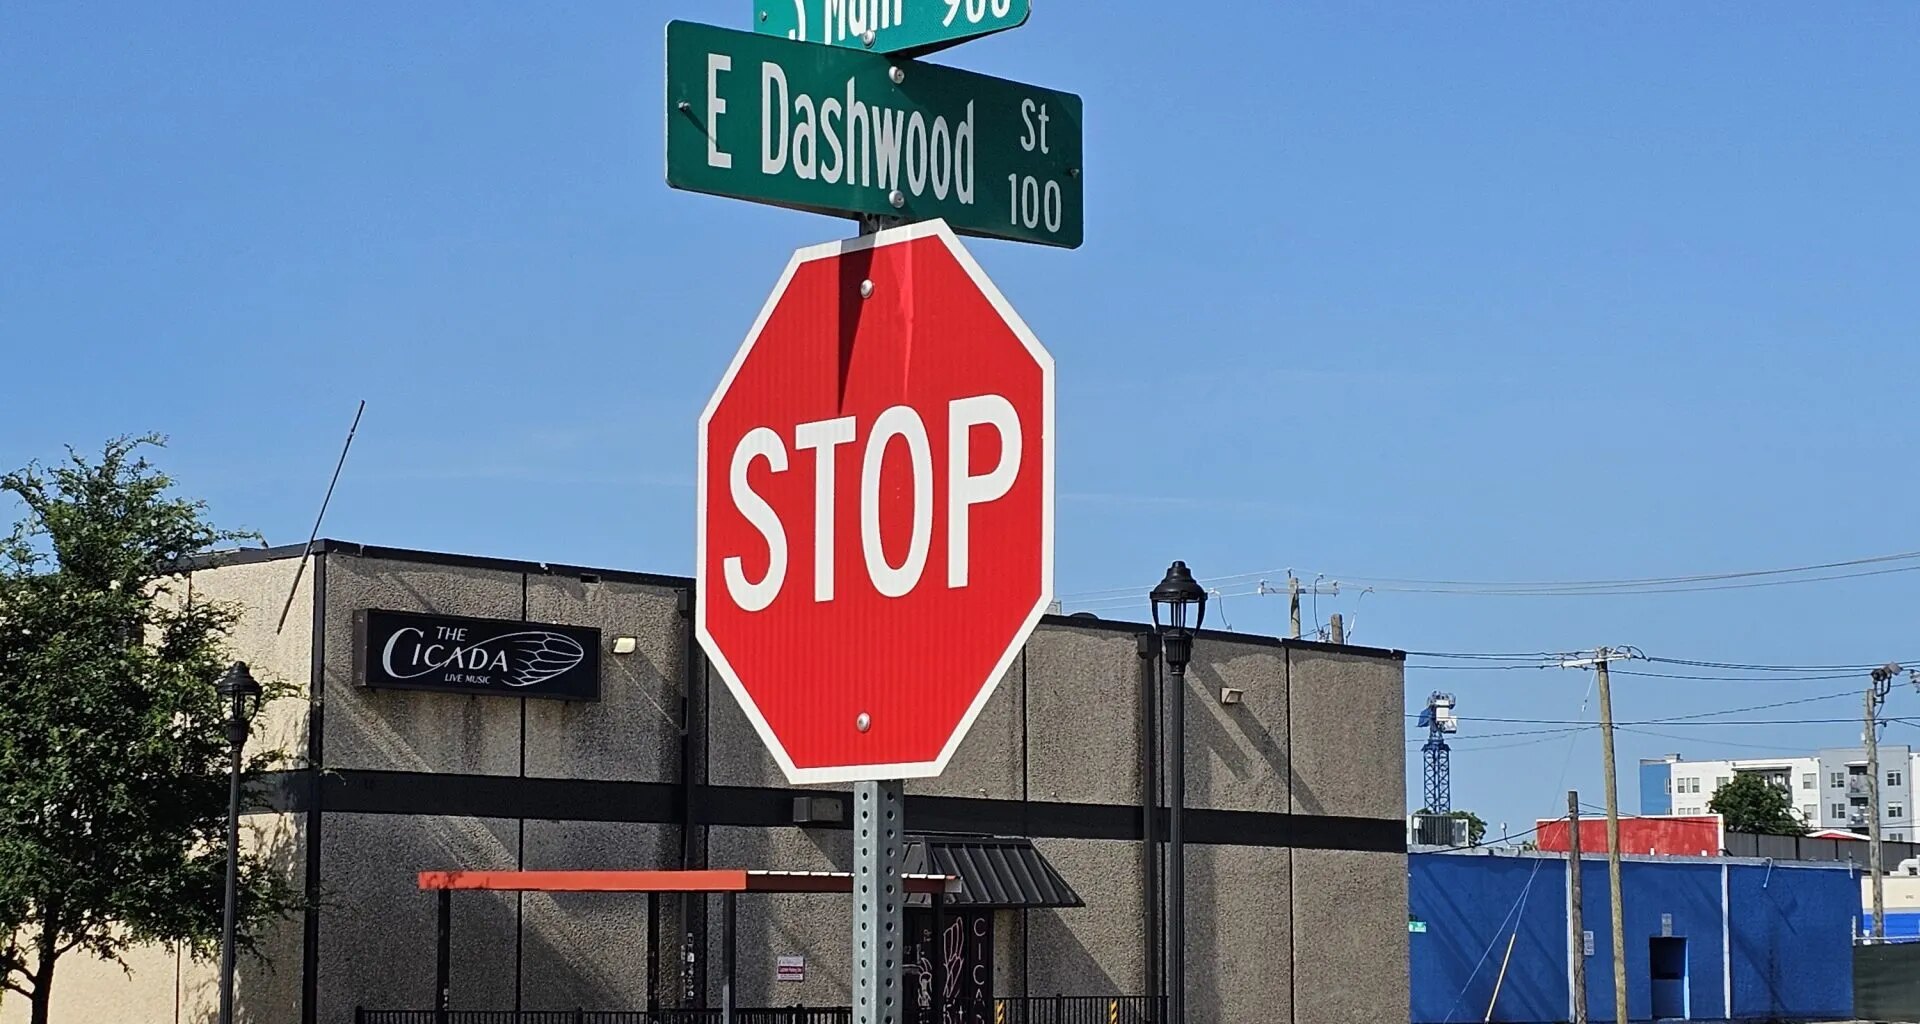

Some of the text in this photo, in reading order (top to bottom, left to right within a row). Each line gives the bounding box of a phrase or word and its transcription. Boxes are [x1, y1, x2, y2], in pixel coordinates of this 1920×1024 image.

[708, 53, 1049, 205] E Dashwood St
[1008, 173, 1062, 233] 100
[723, 394, 1023, 612] STOP
[382, 627, 508, 679] CICADA
[436, 626, 468, 641] THE
[444, 673, 491, 684] LIVE MUSIC
